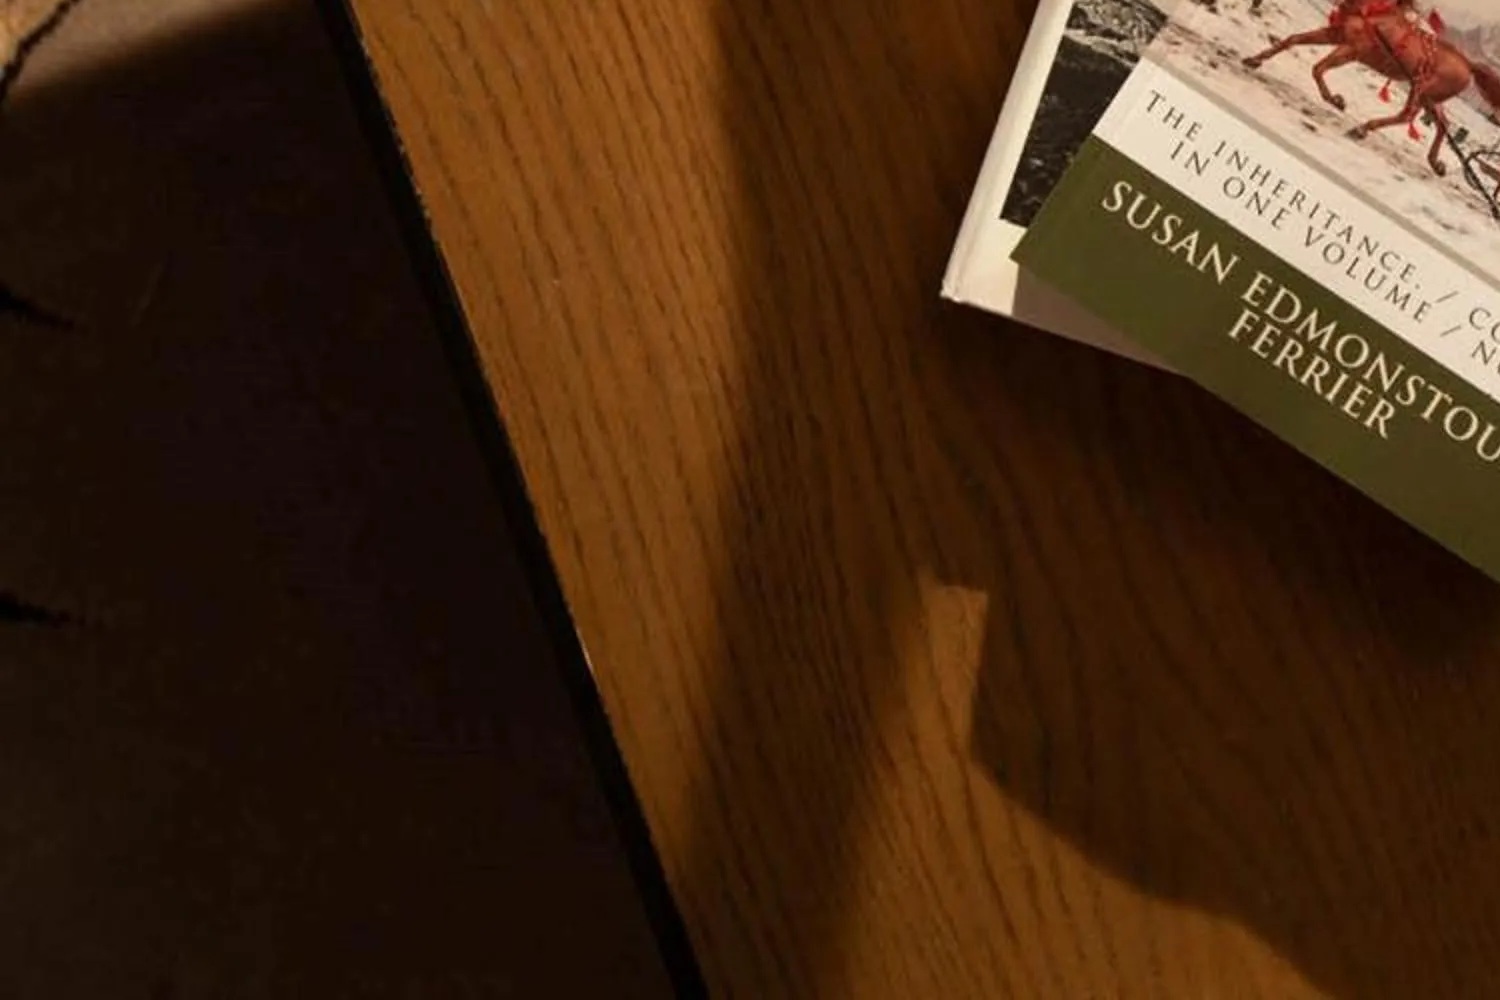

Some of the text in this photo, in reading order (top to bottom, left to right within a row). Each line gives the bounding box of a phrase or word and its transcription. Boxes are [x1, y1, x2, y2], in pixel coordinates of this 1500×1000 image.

[1102, 180, 1239, 285] SUSAN
[1146, 89, 1203, 142] THE
[1213, 140, 1420, 290] INHERITANCE.
[1170, 140, 1212, 177] IN
[1222, 176, 1292, 228] ONE
[1304, 225, 1432, 323] VOLUME
[1227, 308, 1396, 440] FERRIER
